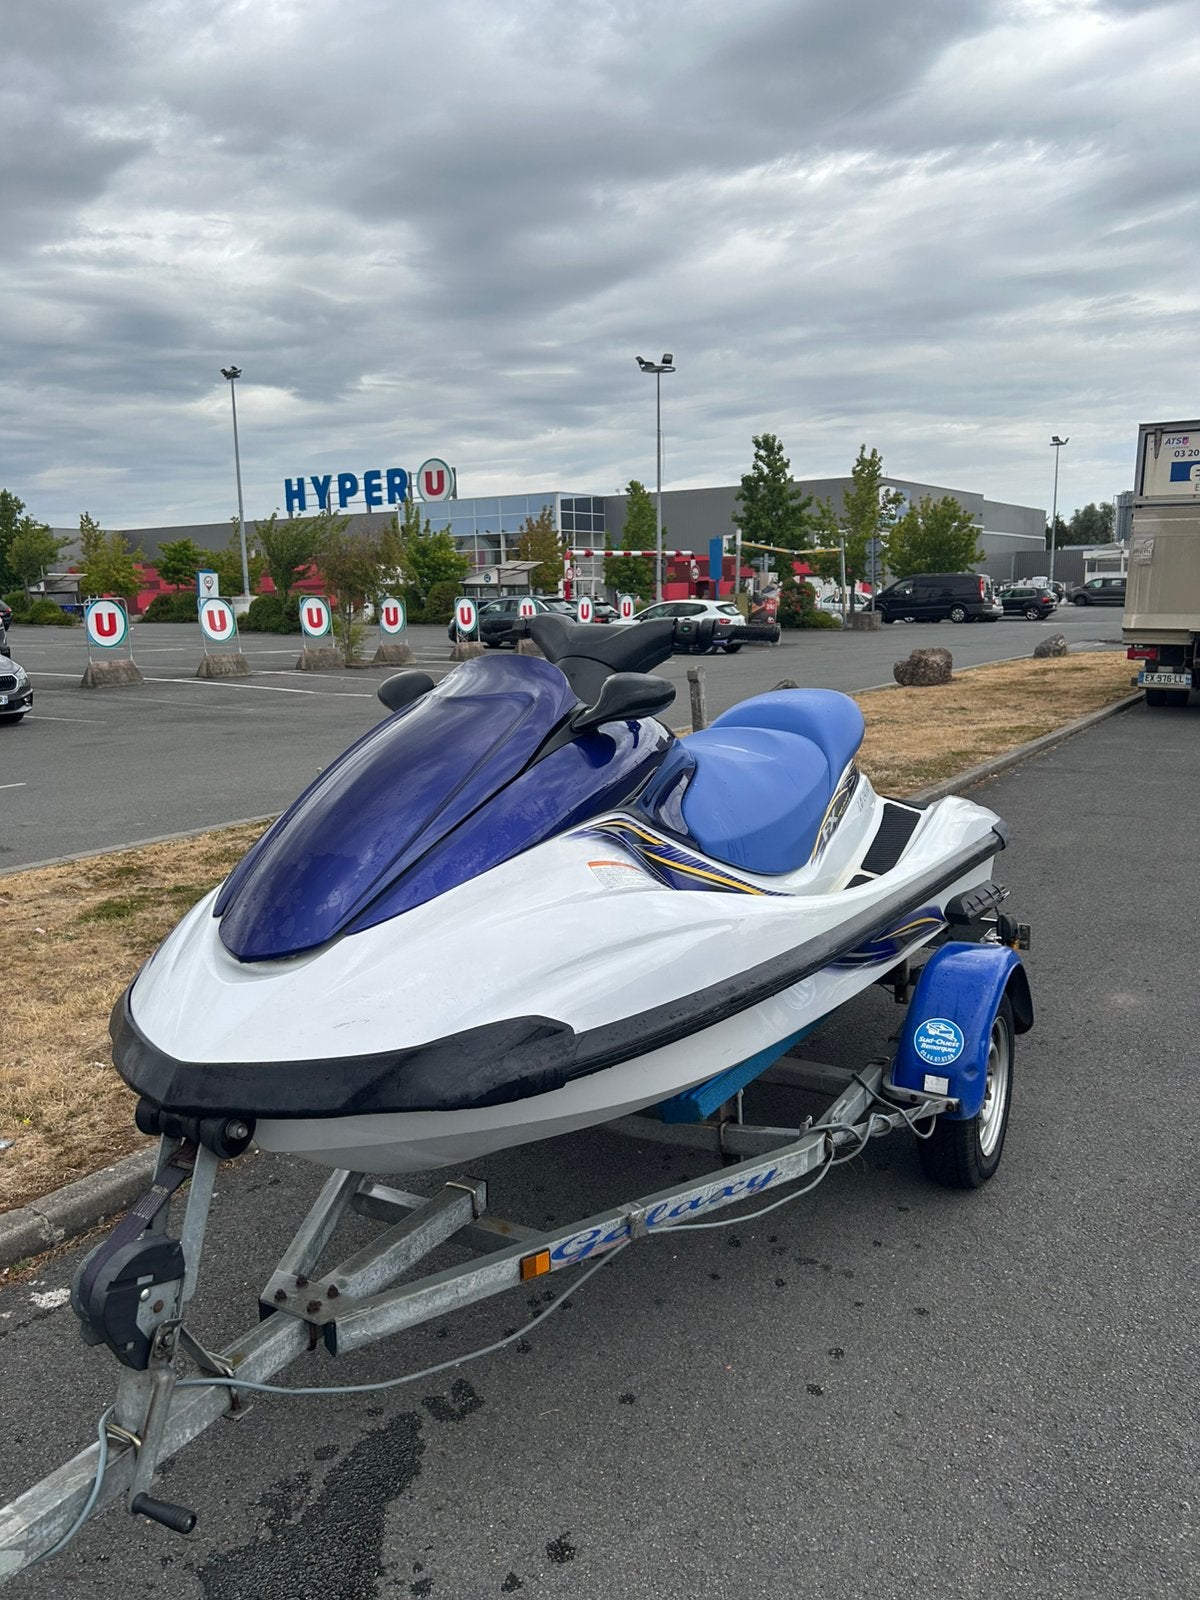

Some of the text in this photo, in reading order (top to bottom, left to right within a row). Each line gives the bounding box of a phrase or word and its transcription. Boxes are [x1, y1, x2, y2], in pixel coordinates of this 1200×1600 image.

[1165, 437, 1182, 445] ATS
[1174, 449, 1200, 458] 03 20
[285, 468, 444, 512] HYPER U
[306, 608, 323, 628] U
[384, 607, 399, 626] U
[460, 607, 472, 625] U
[581, 604, 590, 620] U
[623, 602, 631, 617] U
[95, 612, 117, 637] U
[207, 610, 228, 632] U
[822, 807, 838, 842] FX
[918, 1036, 959, 1048] Sud-Ouest
[921, 1043, 956, 1053] Remorques
[551, 1168, 782, 1263] Galaxy
